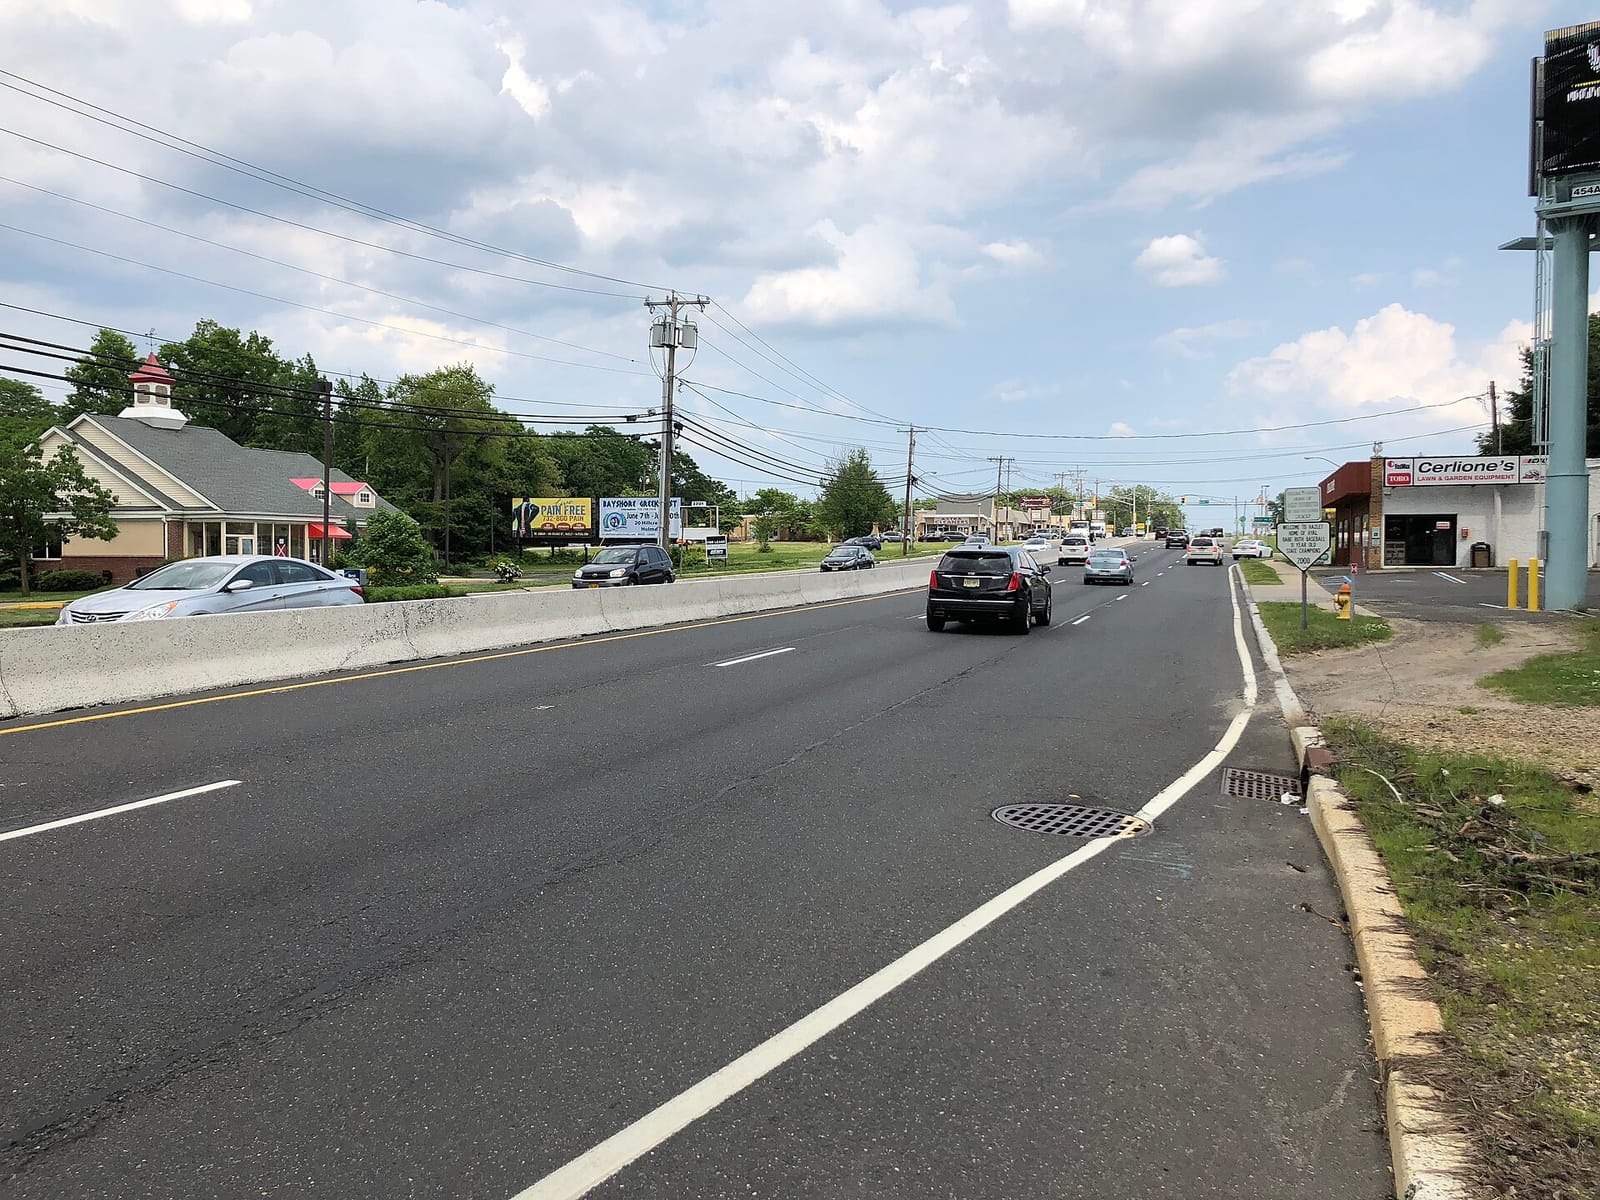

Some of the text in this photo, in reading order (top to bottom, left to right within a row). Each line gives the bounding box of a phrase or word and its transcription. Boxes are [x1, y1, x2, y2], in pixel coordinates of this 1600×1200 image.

[1418, 460, 1515, 473] Cerlione's
[541, 505, 586, 516] PAIN FREE
